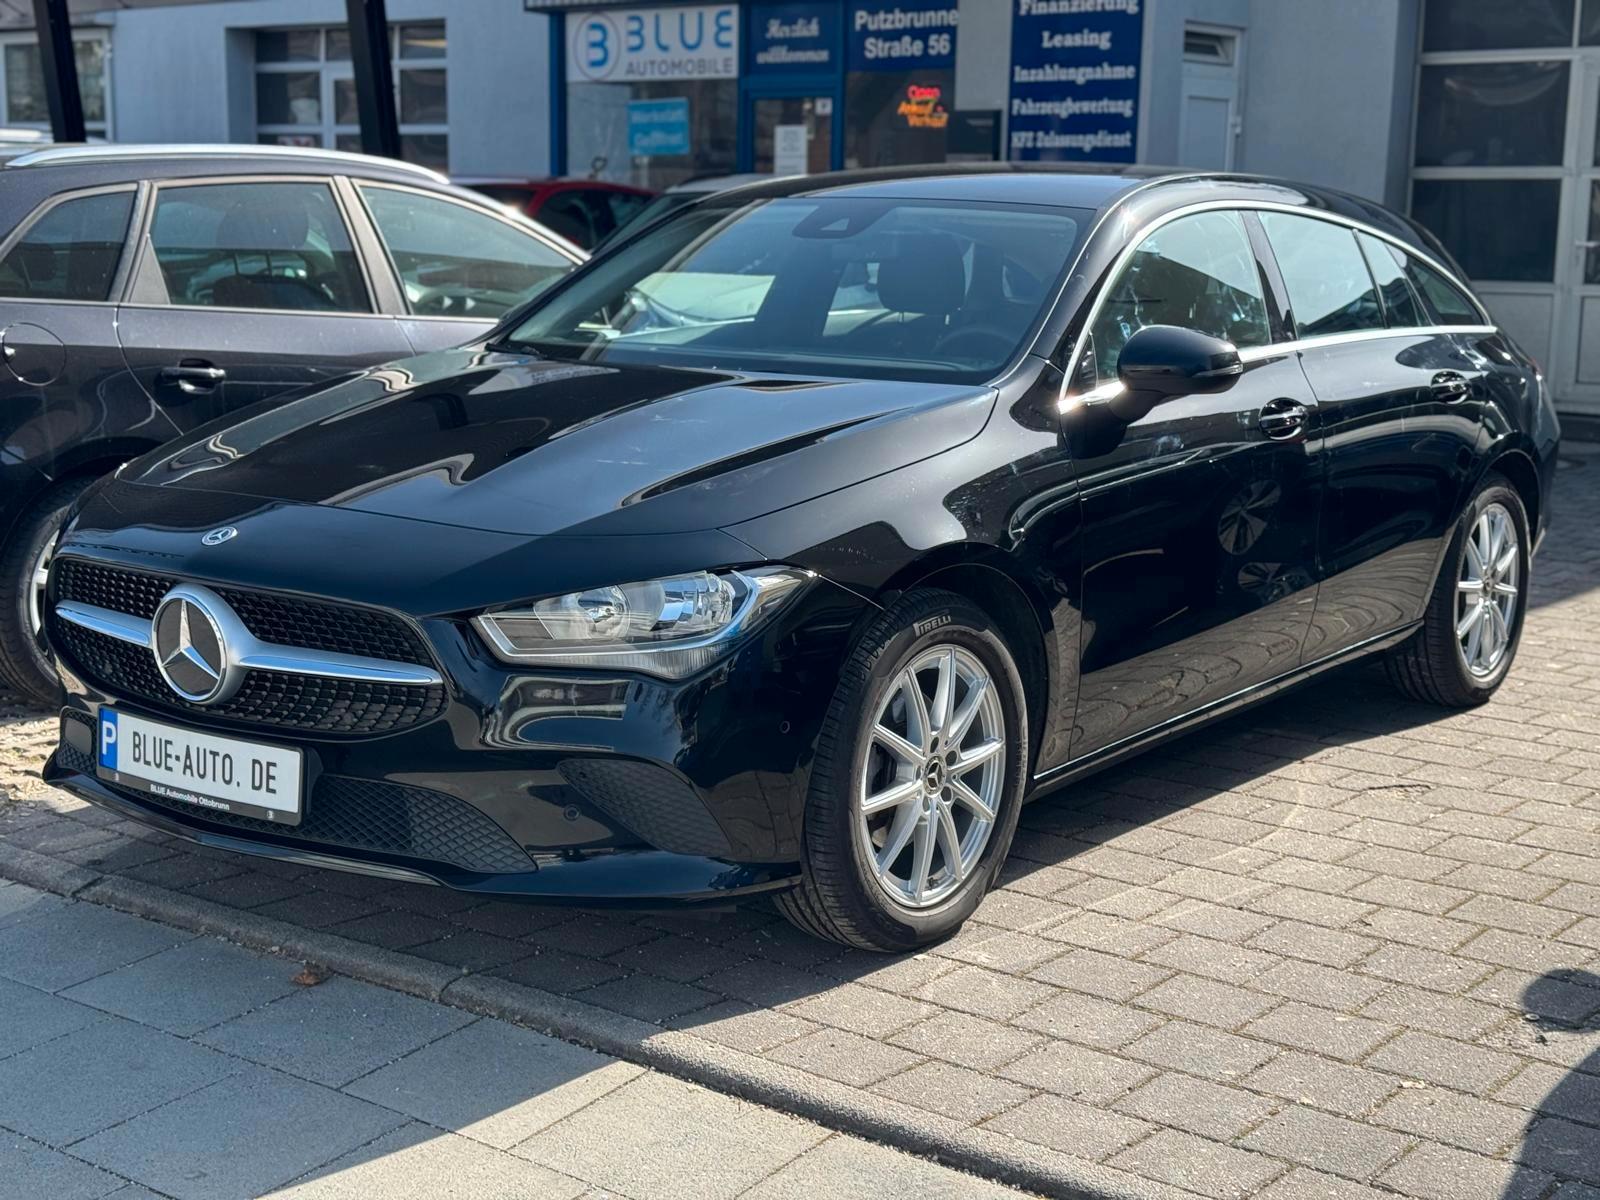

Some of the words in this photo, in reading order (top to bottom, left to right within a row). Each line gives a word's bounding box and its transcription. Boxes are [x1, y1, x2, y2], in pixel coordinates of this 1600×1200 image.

[1019, 0, 1139, 16] Finanzierung
[625, 9, 733, 52] BLUE
[1041, 28, 1111, 50] Leasing
[864, 35, 924, 59] Straße
[928, 33, 951, 56] 56
[625, 57, 733, 75] AUTOMOBILE
[1013, 62, 1135, 85] Inzahlungnahme
[1011, 97, 1133, 118] Fahrzeugbewertung
[912, 615, 951, 637] PIRELLI
[102, 721, 117, 756] P
[150, 783, 166, 796] BLUE
[199, 796, 230, 811] Ottobrunn
